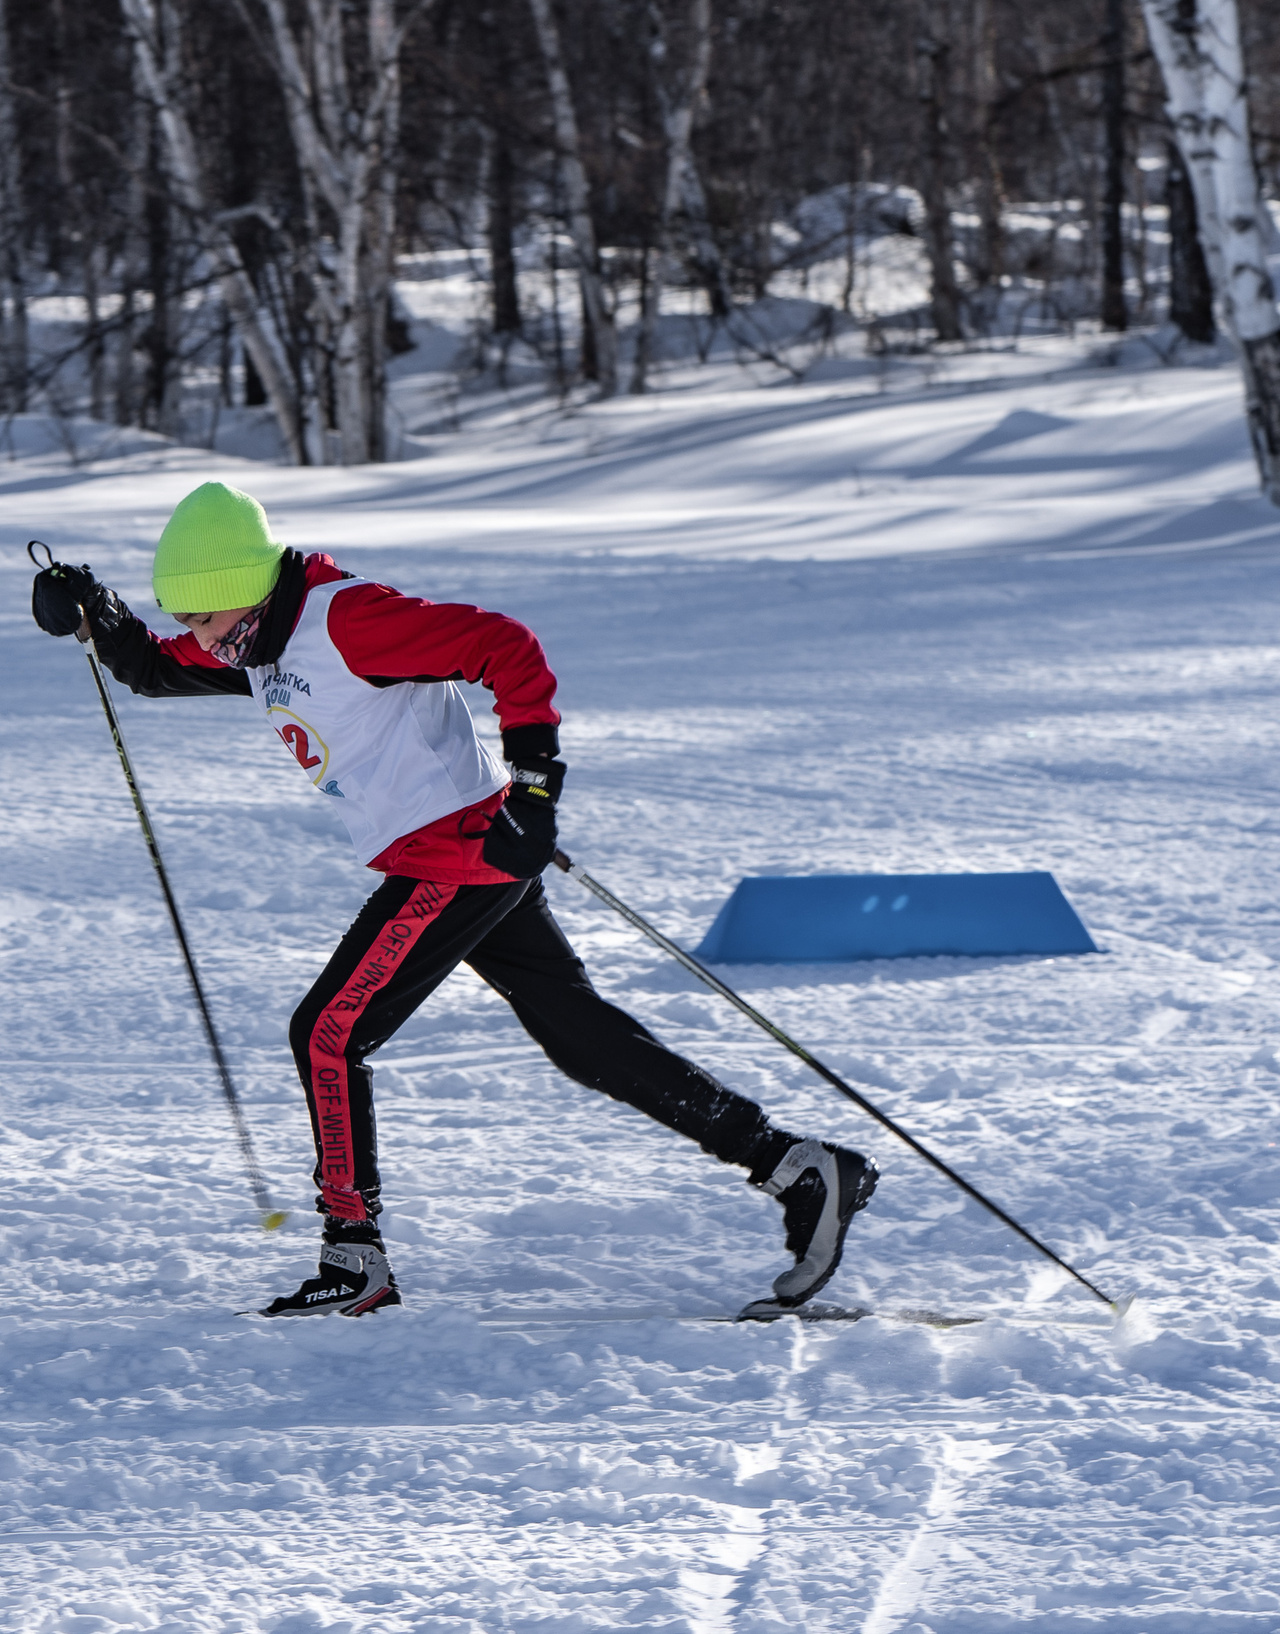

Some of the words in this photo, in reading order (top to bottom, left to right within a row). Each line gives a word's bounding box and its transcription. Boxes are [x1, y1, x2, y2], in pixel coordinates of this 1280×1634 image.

[274, 724, 322, 769] 2
[335, 923, 412, 1012] OFF-WHITE
[318, 1068, 349, 1176] OFF-WHITE
[324, 1250, 348, 1266] TISA
[305, 1288, 338, 1303] TISA
